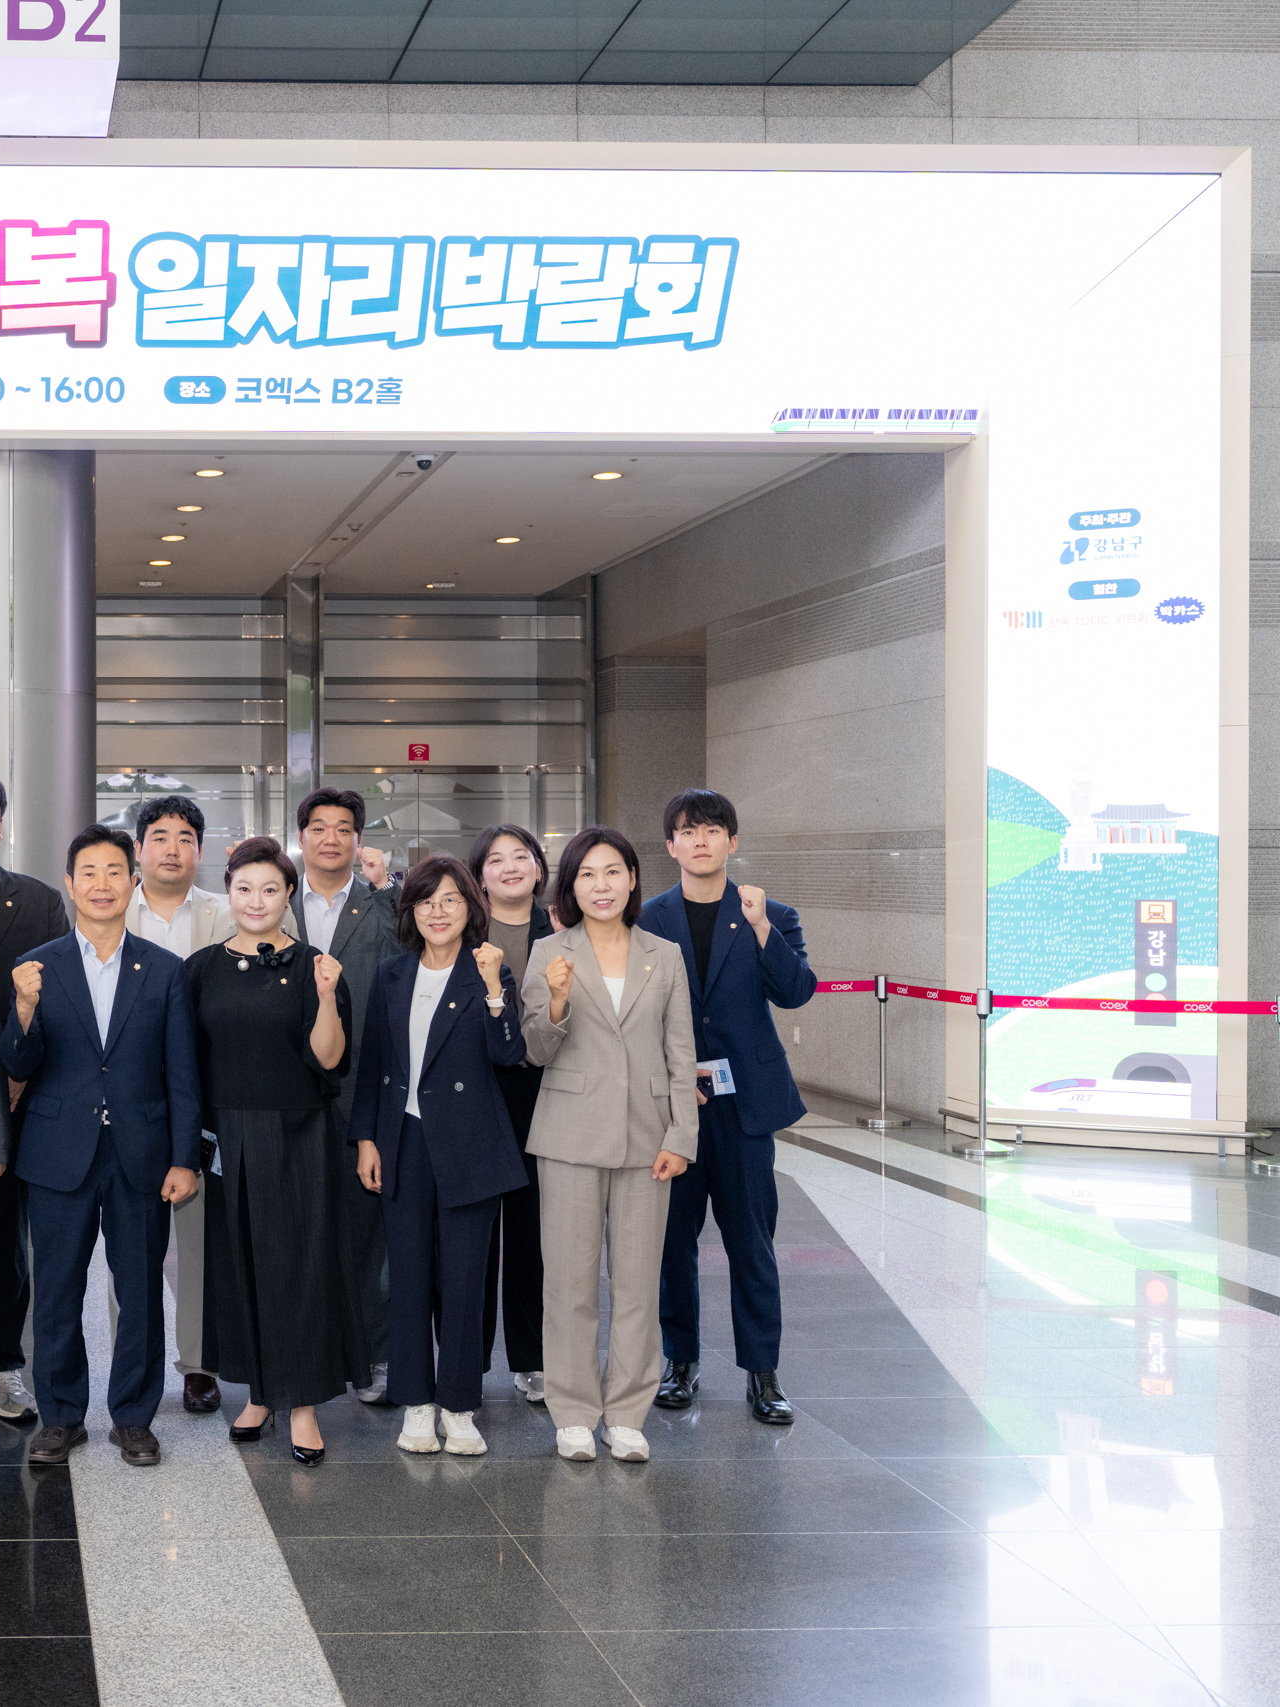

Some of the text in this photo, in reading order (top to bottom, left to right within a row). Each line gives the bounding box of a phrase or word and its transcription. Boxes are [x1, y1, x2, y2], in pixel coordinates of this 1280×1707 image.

[128, 231, 435, 348] 일자리
[434, 236, 739, 350] 박람회
[40, 376, 126, 403] 16:00
[179, 381, 211, 398] 장소
[234, 377, 321, 404] 코엑스
[331, 377, 404, 405] B2홀
[1094, 536, 1143, 552] 강남구
[1159, 604, 1200, 617] 박카스
[1147, 930, 1166, 967] 강남
[831, 982, 853, 991] coex
[896, 986, 973, 1003] coex coex coex
[1022, 998, 1213, 1011] coex coex coex
